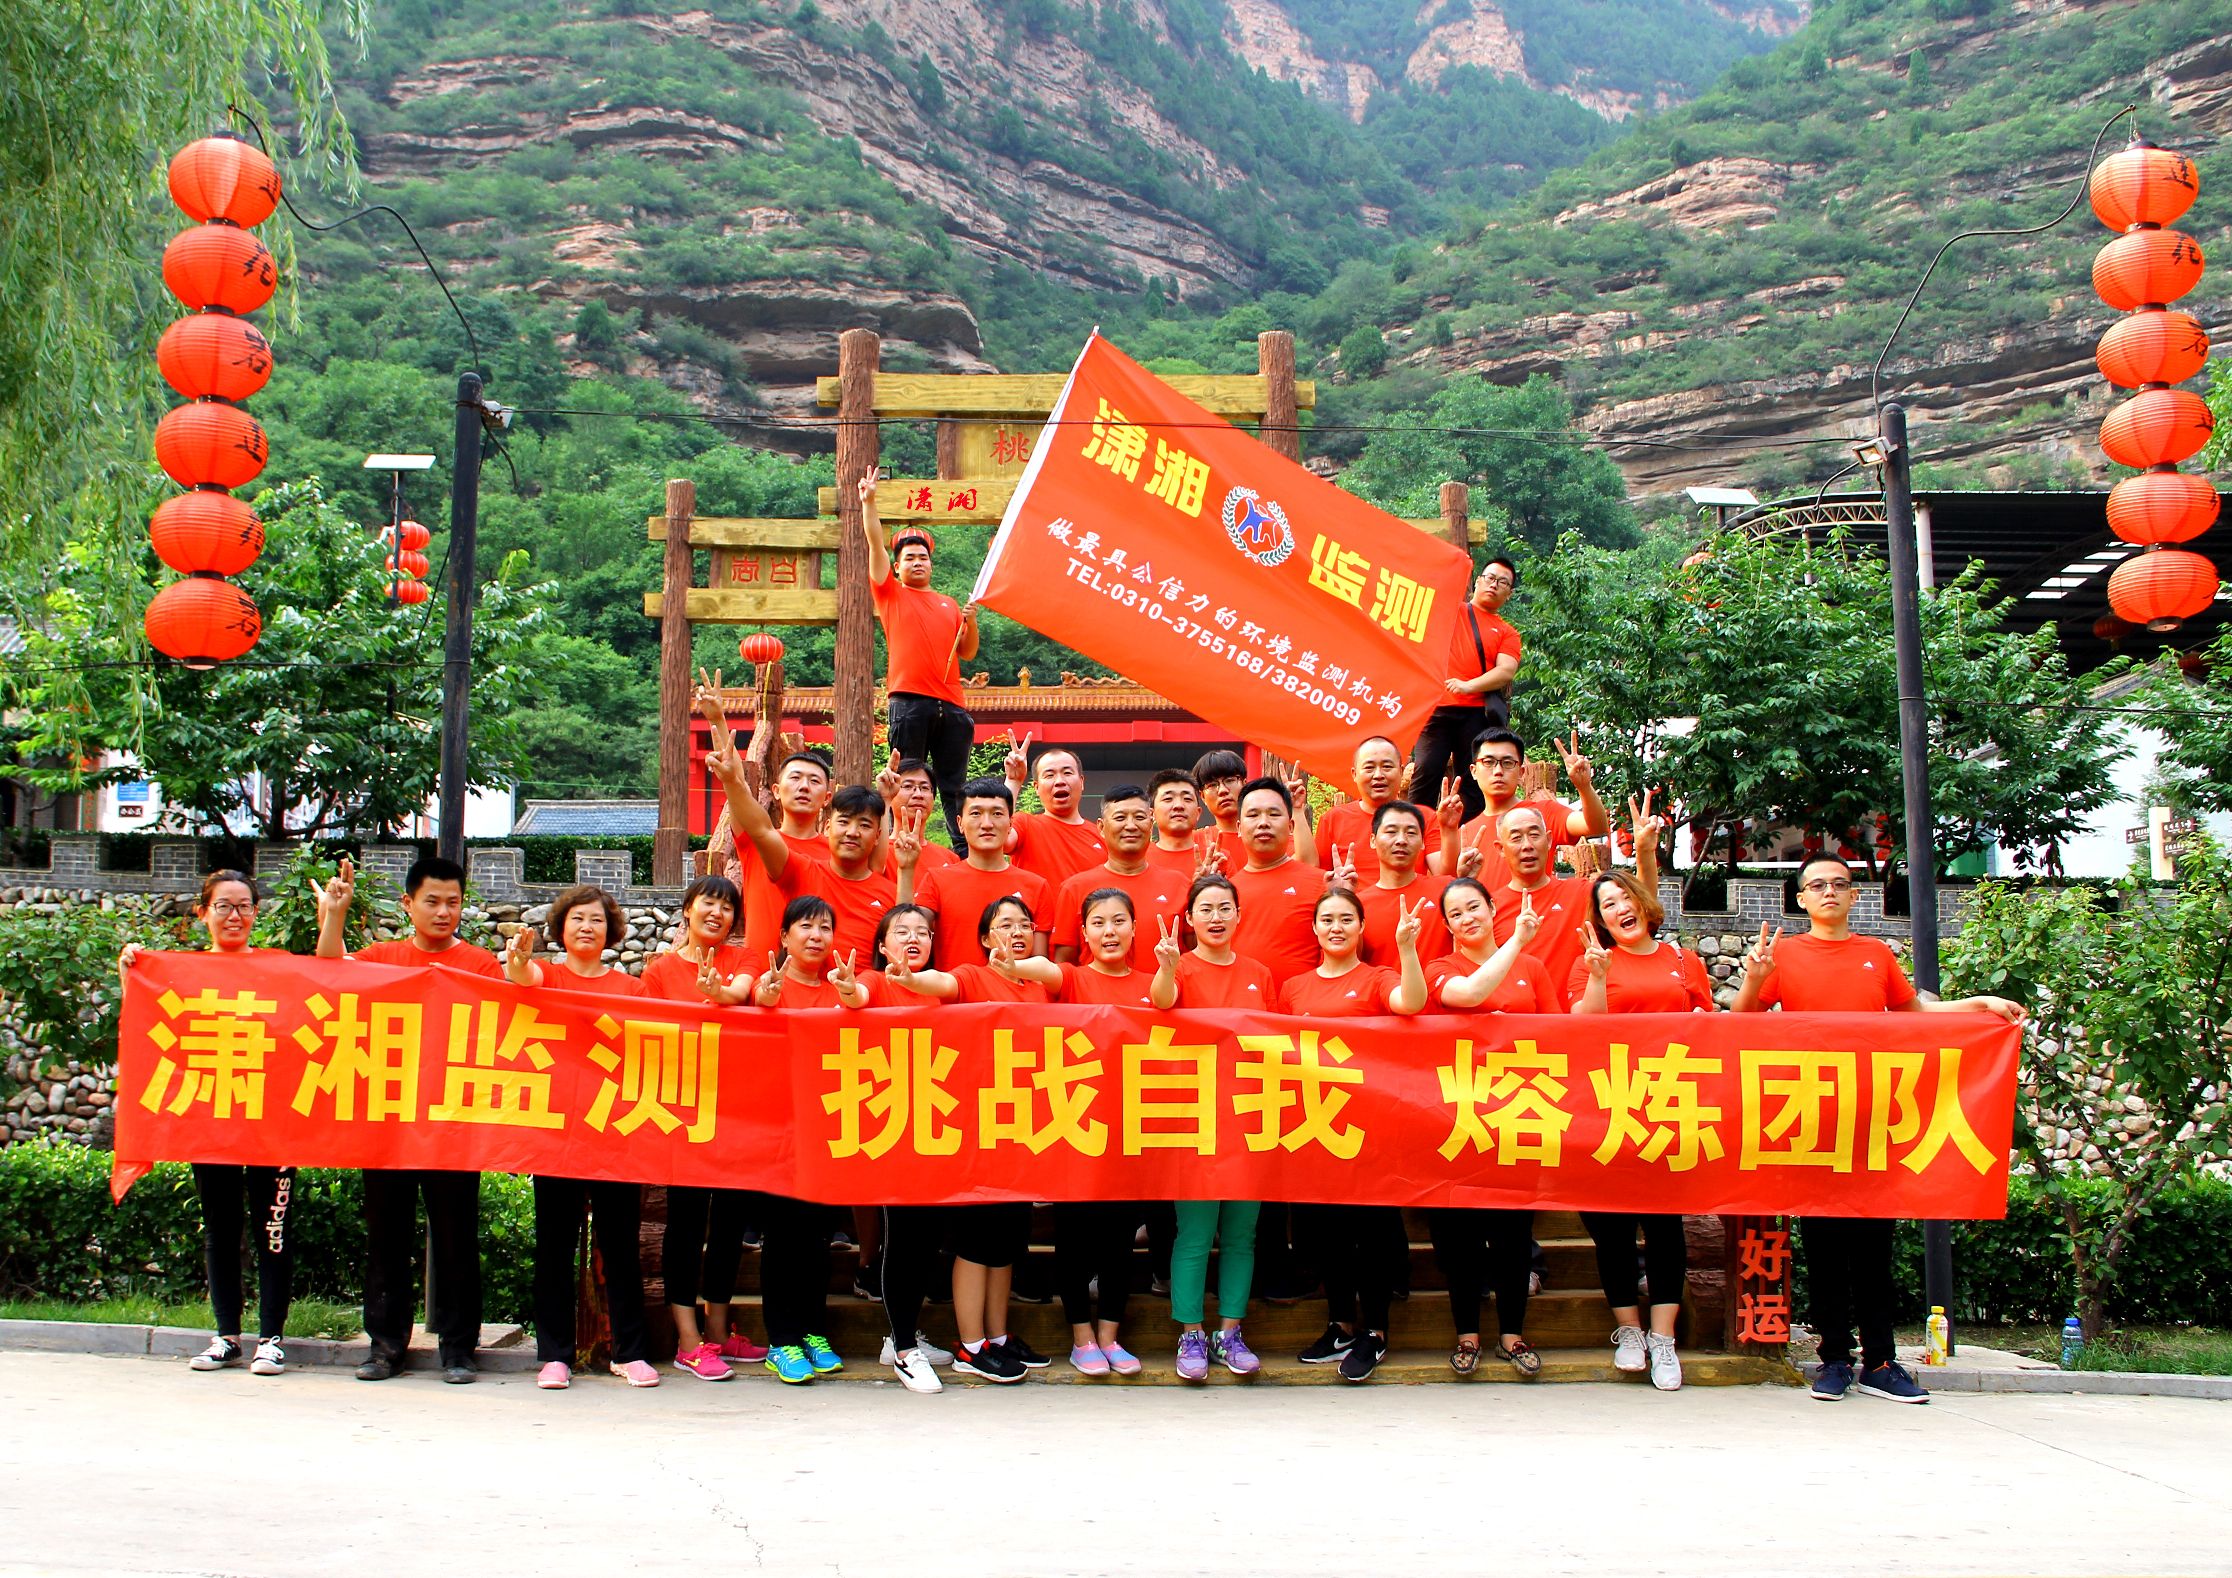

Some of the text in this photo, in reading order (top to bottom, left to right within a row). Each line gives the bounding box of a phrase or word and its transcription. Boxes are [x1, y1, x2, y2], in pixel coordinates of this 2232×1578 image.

[989, 429, 1031, 466] 桃
[1081, 396, 1437, 645] 潇湘 监测
[1047, 516, 1403, 720] 做最具公信力的环境监测机构
[1065, 556, 1362, 726] TEL:0310-3755168/3820099
[138, 988, 1998, 1176] 潇湘监测 挑战自我 熔炼团队
[265, 1177, 291, 1253] adidas
[1737, 1228, 1792, 1343] 好运
